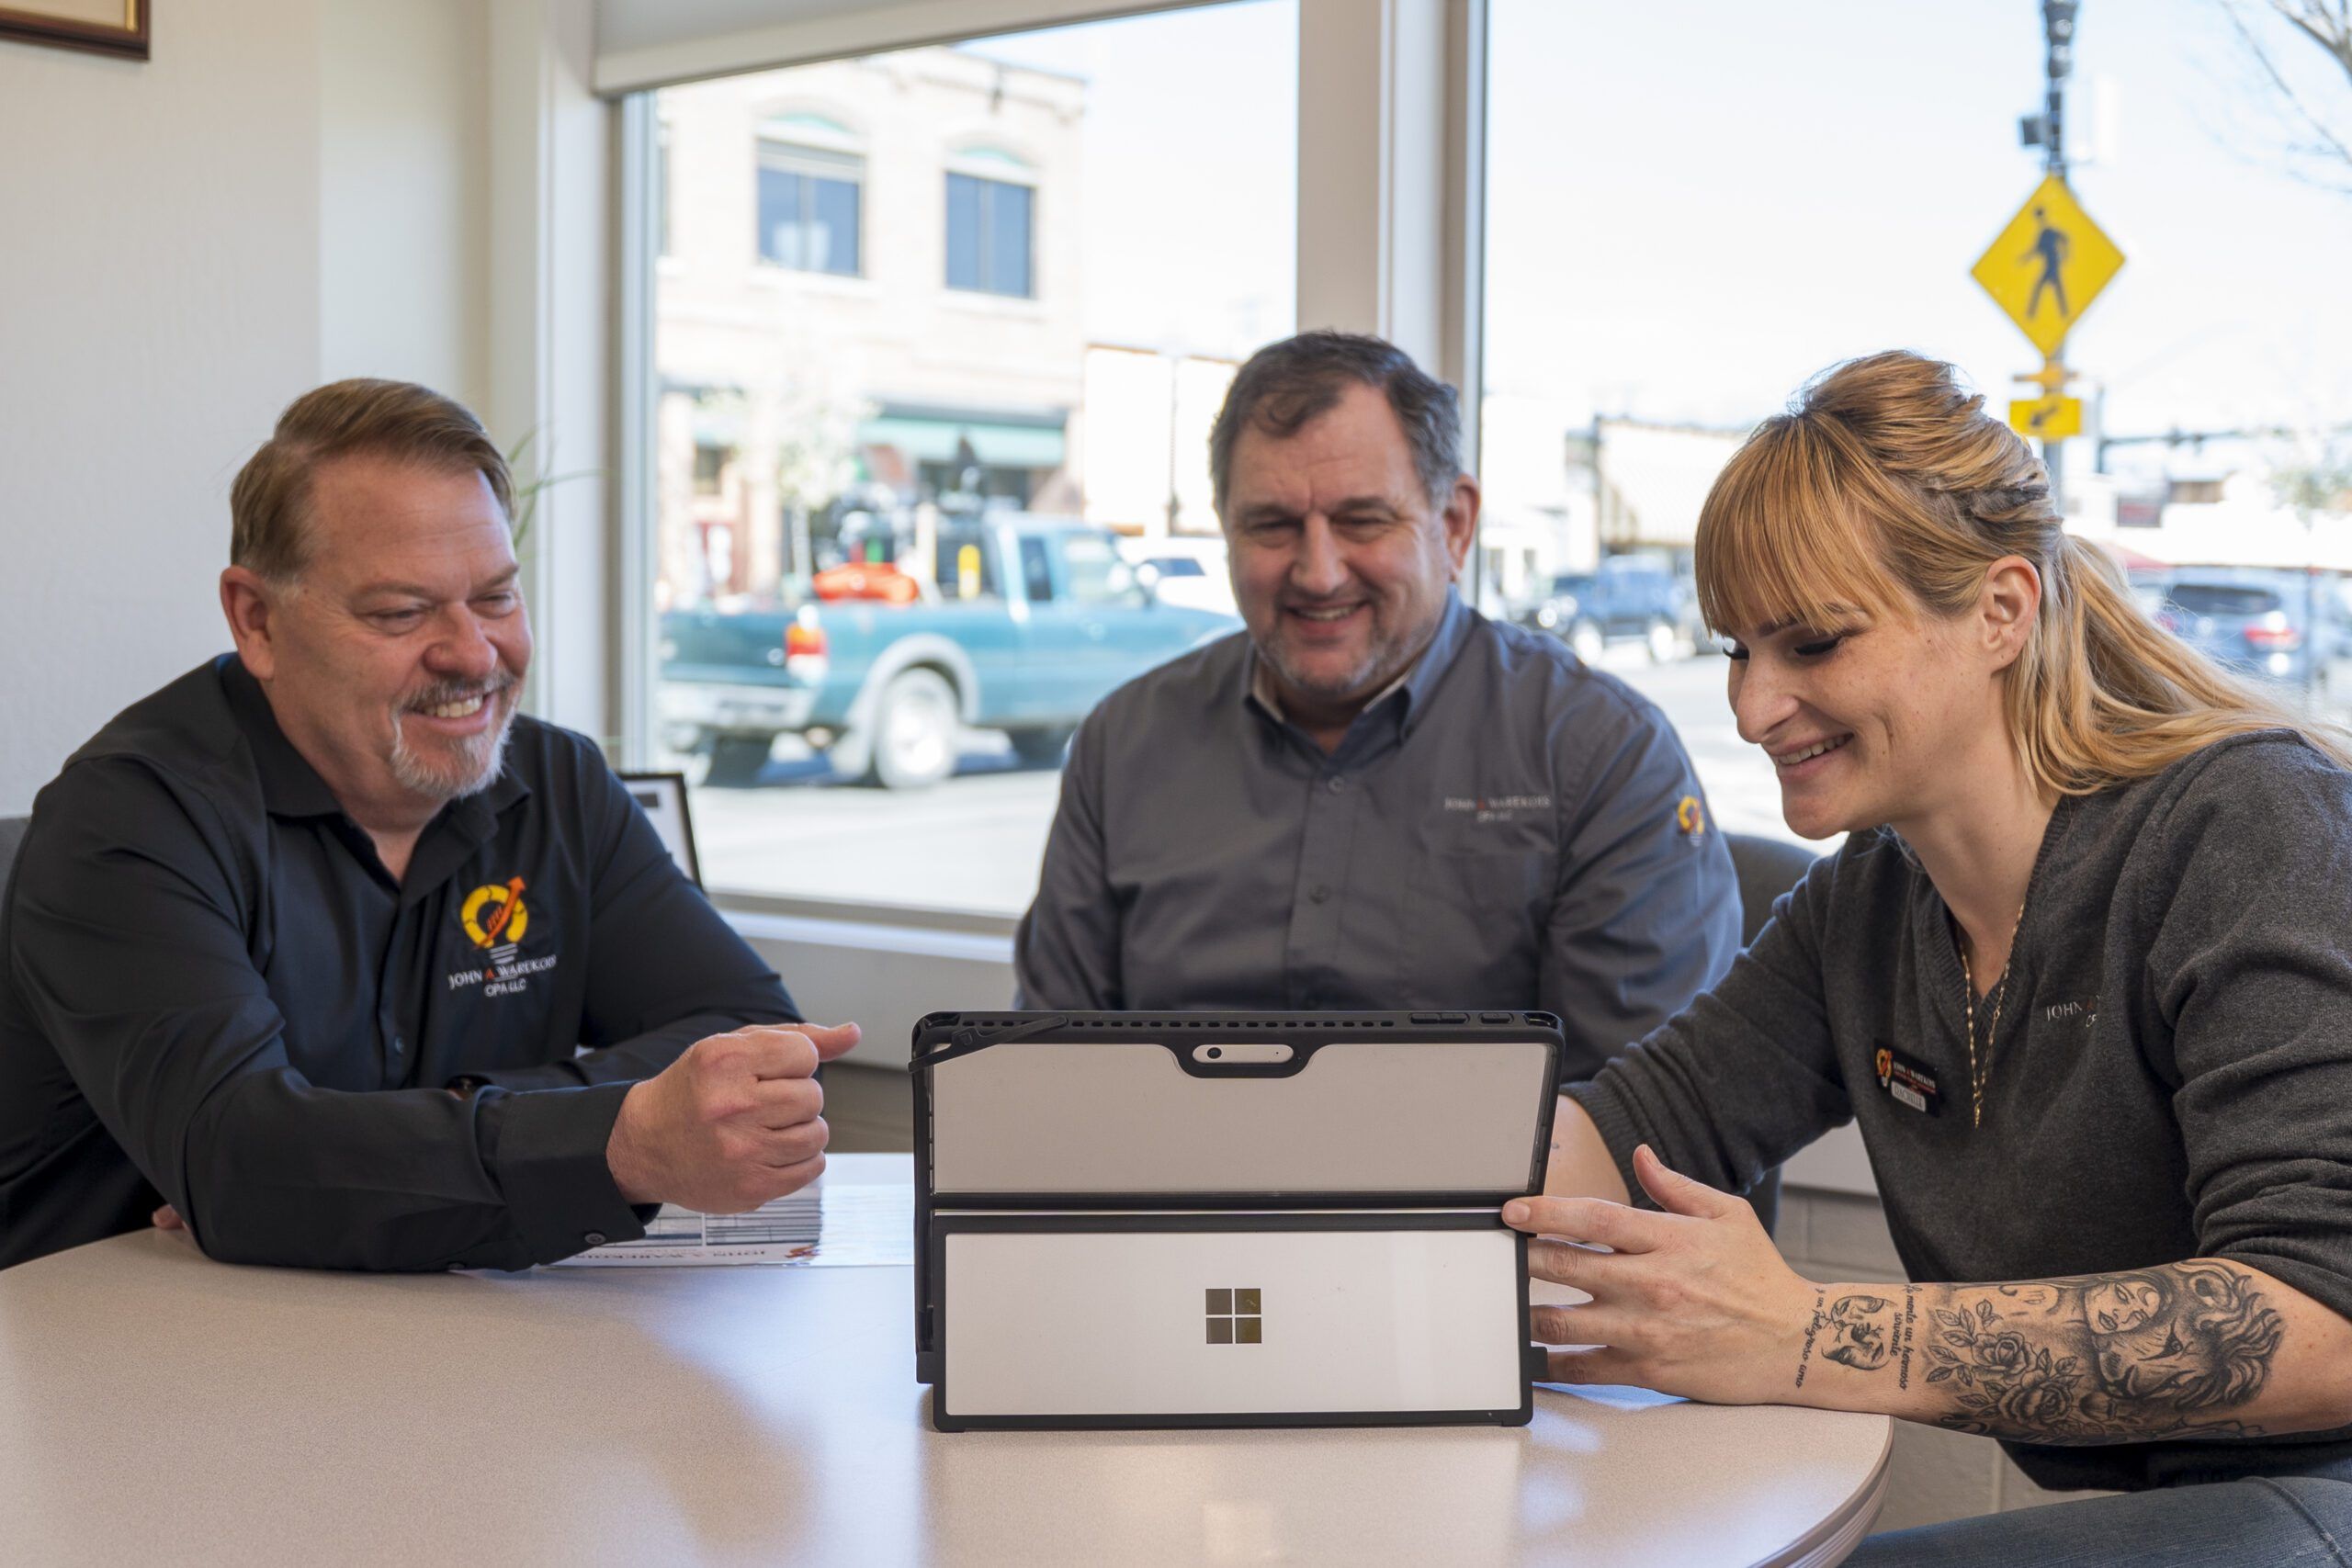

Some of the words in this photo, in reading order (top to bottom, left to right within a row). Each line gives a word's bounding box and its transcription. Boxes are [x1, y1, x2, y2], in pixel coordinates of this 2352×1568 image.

[447, 969, 483, 990] JOHN
[484, 968, 495, 980] A
[484, 982, 508, 998] CPA
[508, 978, 527, 993] LLC
[2046, 1000, 2084, 1021] JOHN
[1816, 1296, 1825, 1308] un
[1905, 1294, 1917, 1324] mente
[1802, 1308, 1823, 1361] peligroso
[1905, 1327, 1913, 1342] un
[1795, 1364, 1807, 1389] amo
